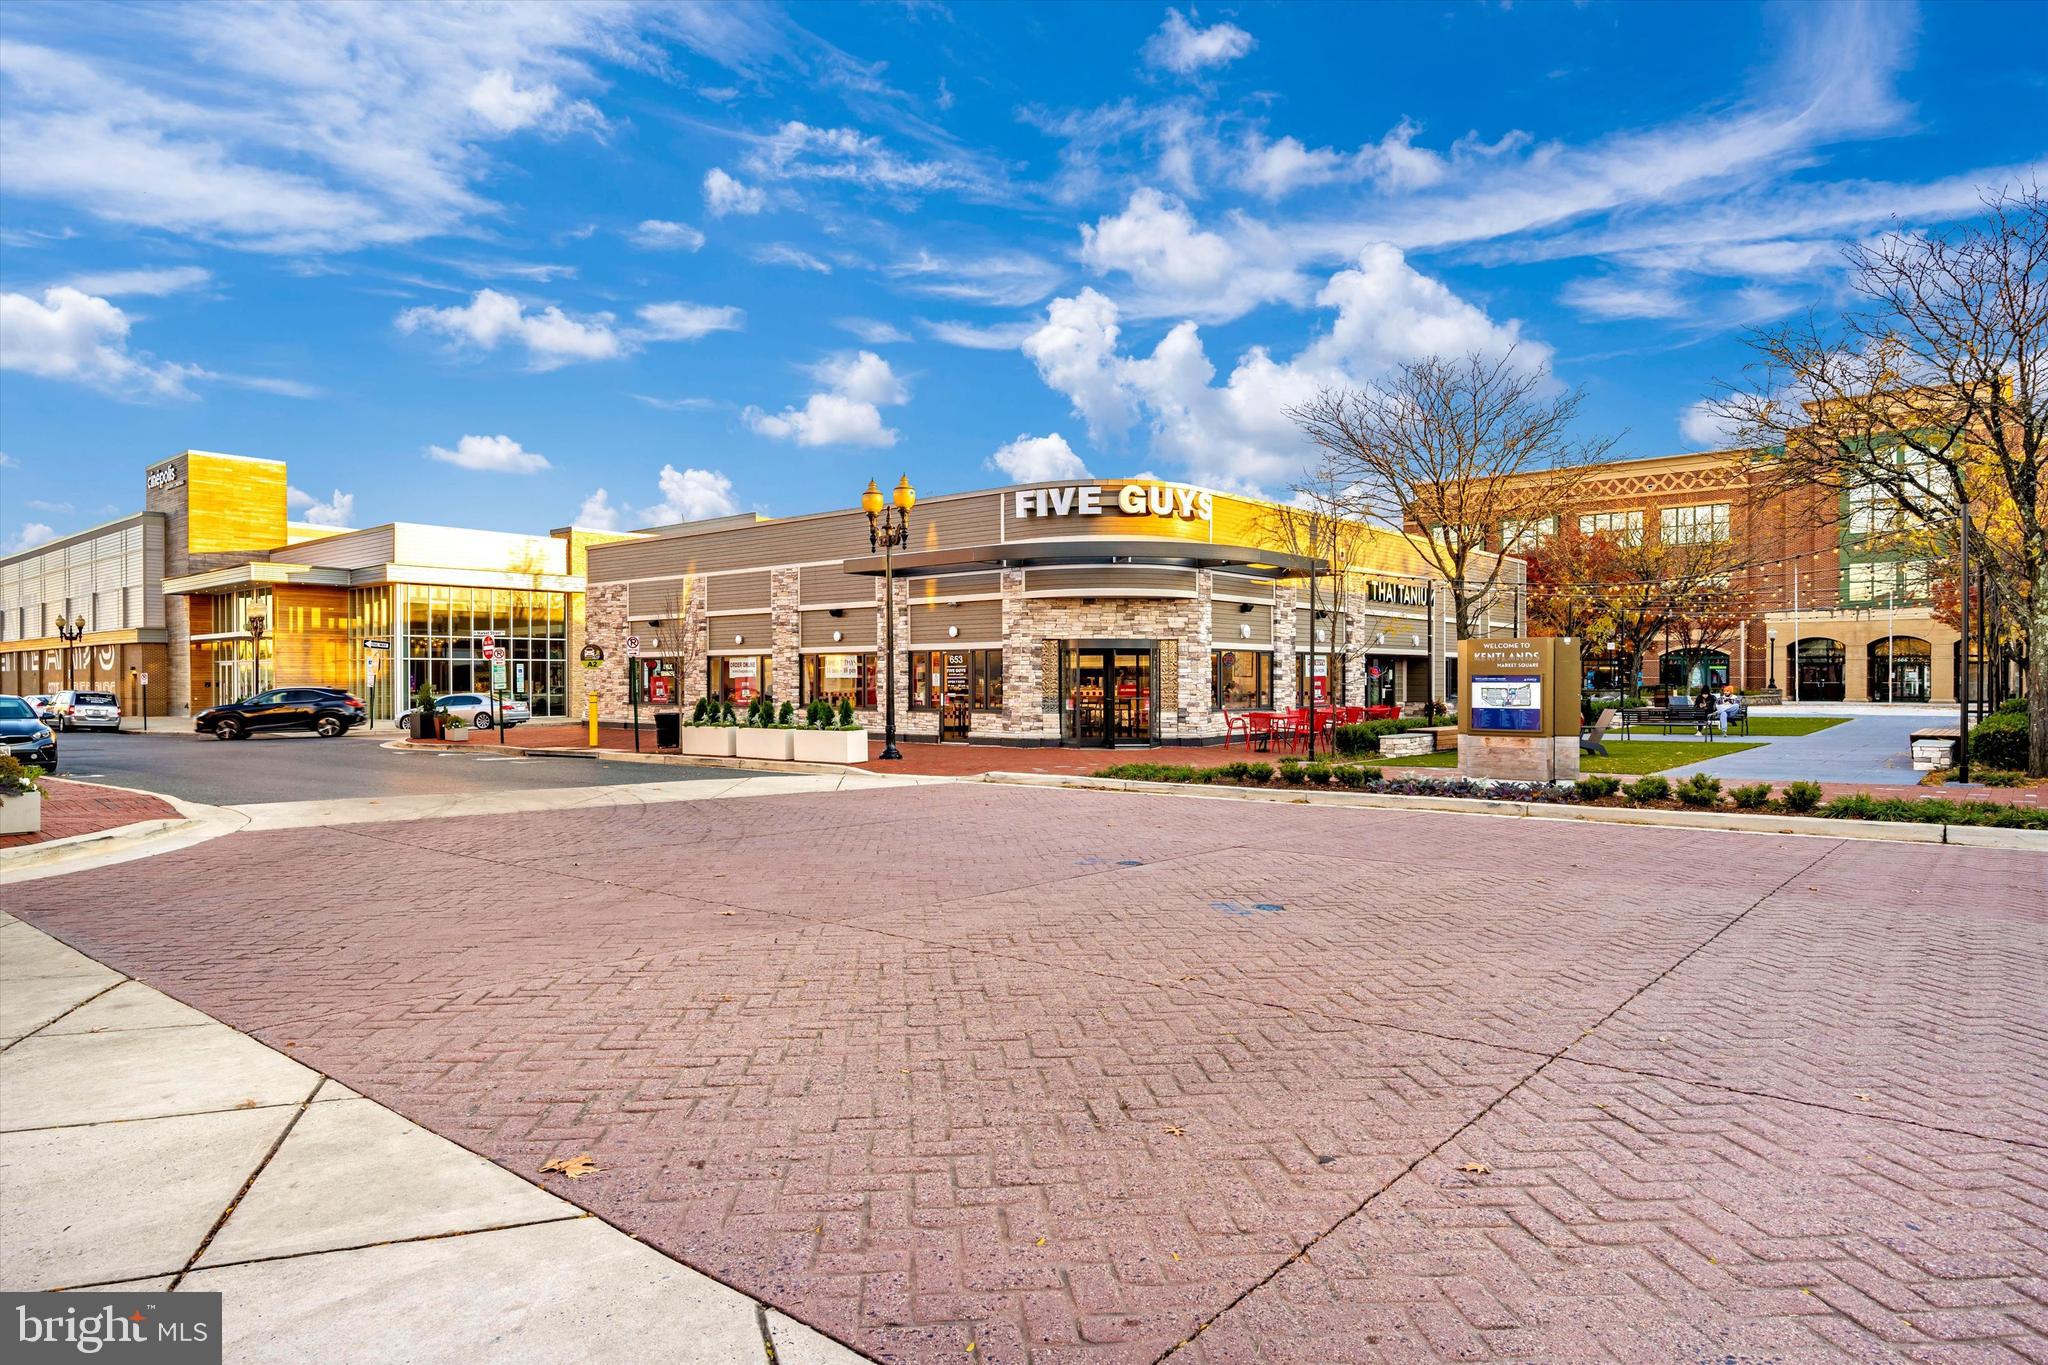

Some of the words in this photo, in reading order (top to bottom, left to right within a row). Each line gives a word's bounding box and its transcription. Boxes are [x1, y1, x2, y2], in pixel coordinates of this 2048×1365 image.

[1015, 486, 1102, 518] FIVE
[1118, 485, 1212, 521] GUYS
[1371, 580, 1396, 602] THAI
[949, 655, 963, 664] 653
[1474, 651, 1540, 661] KENTLANDS
